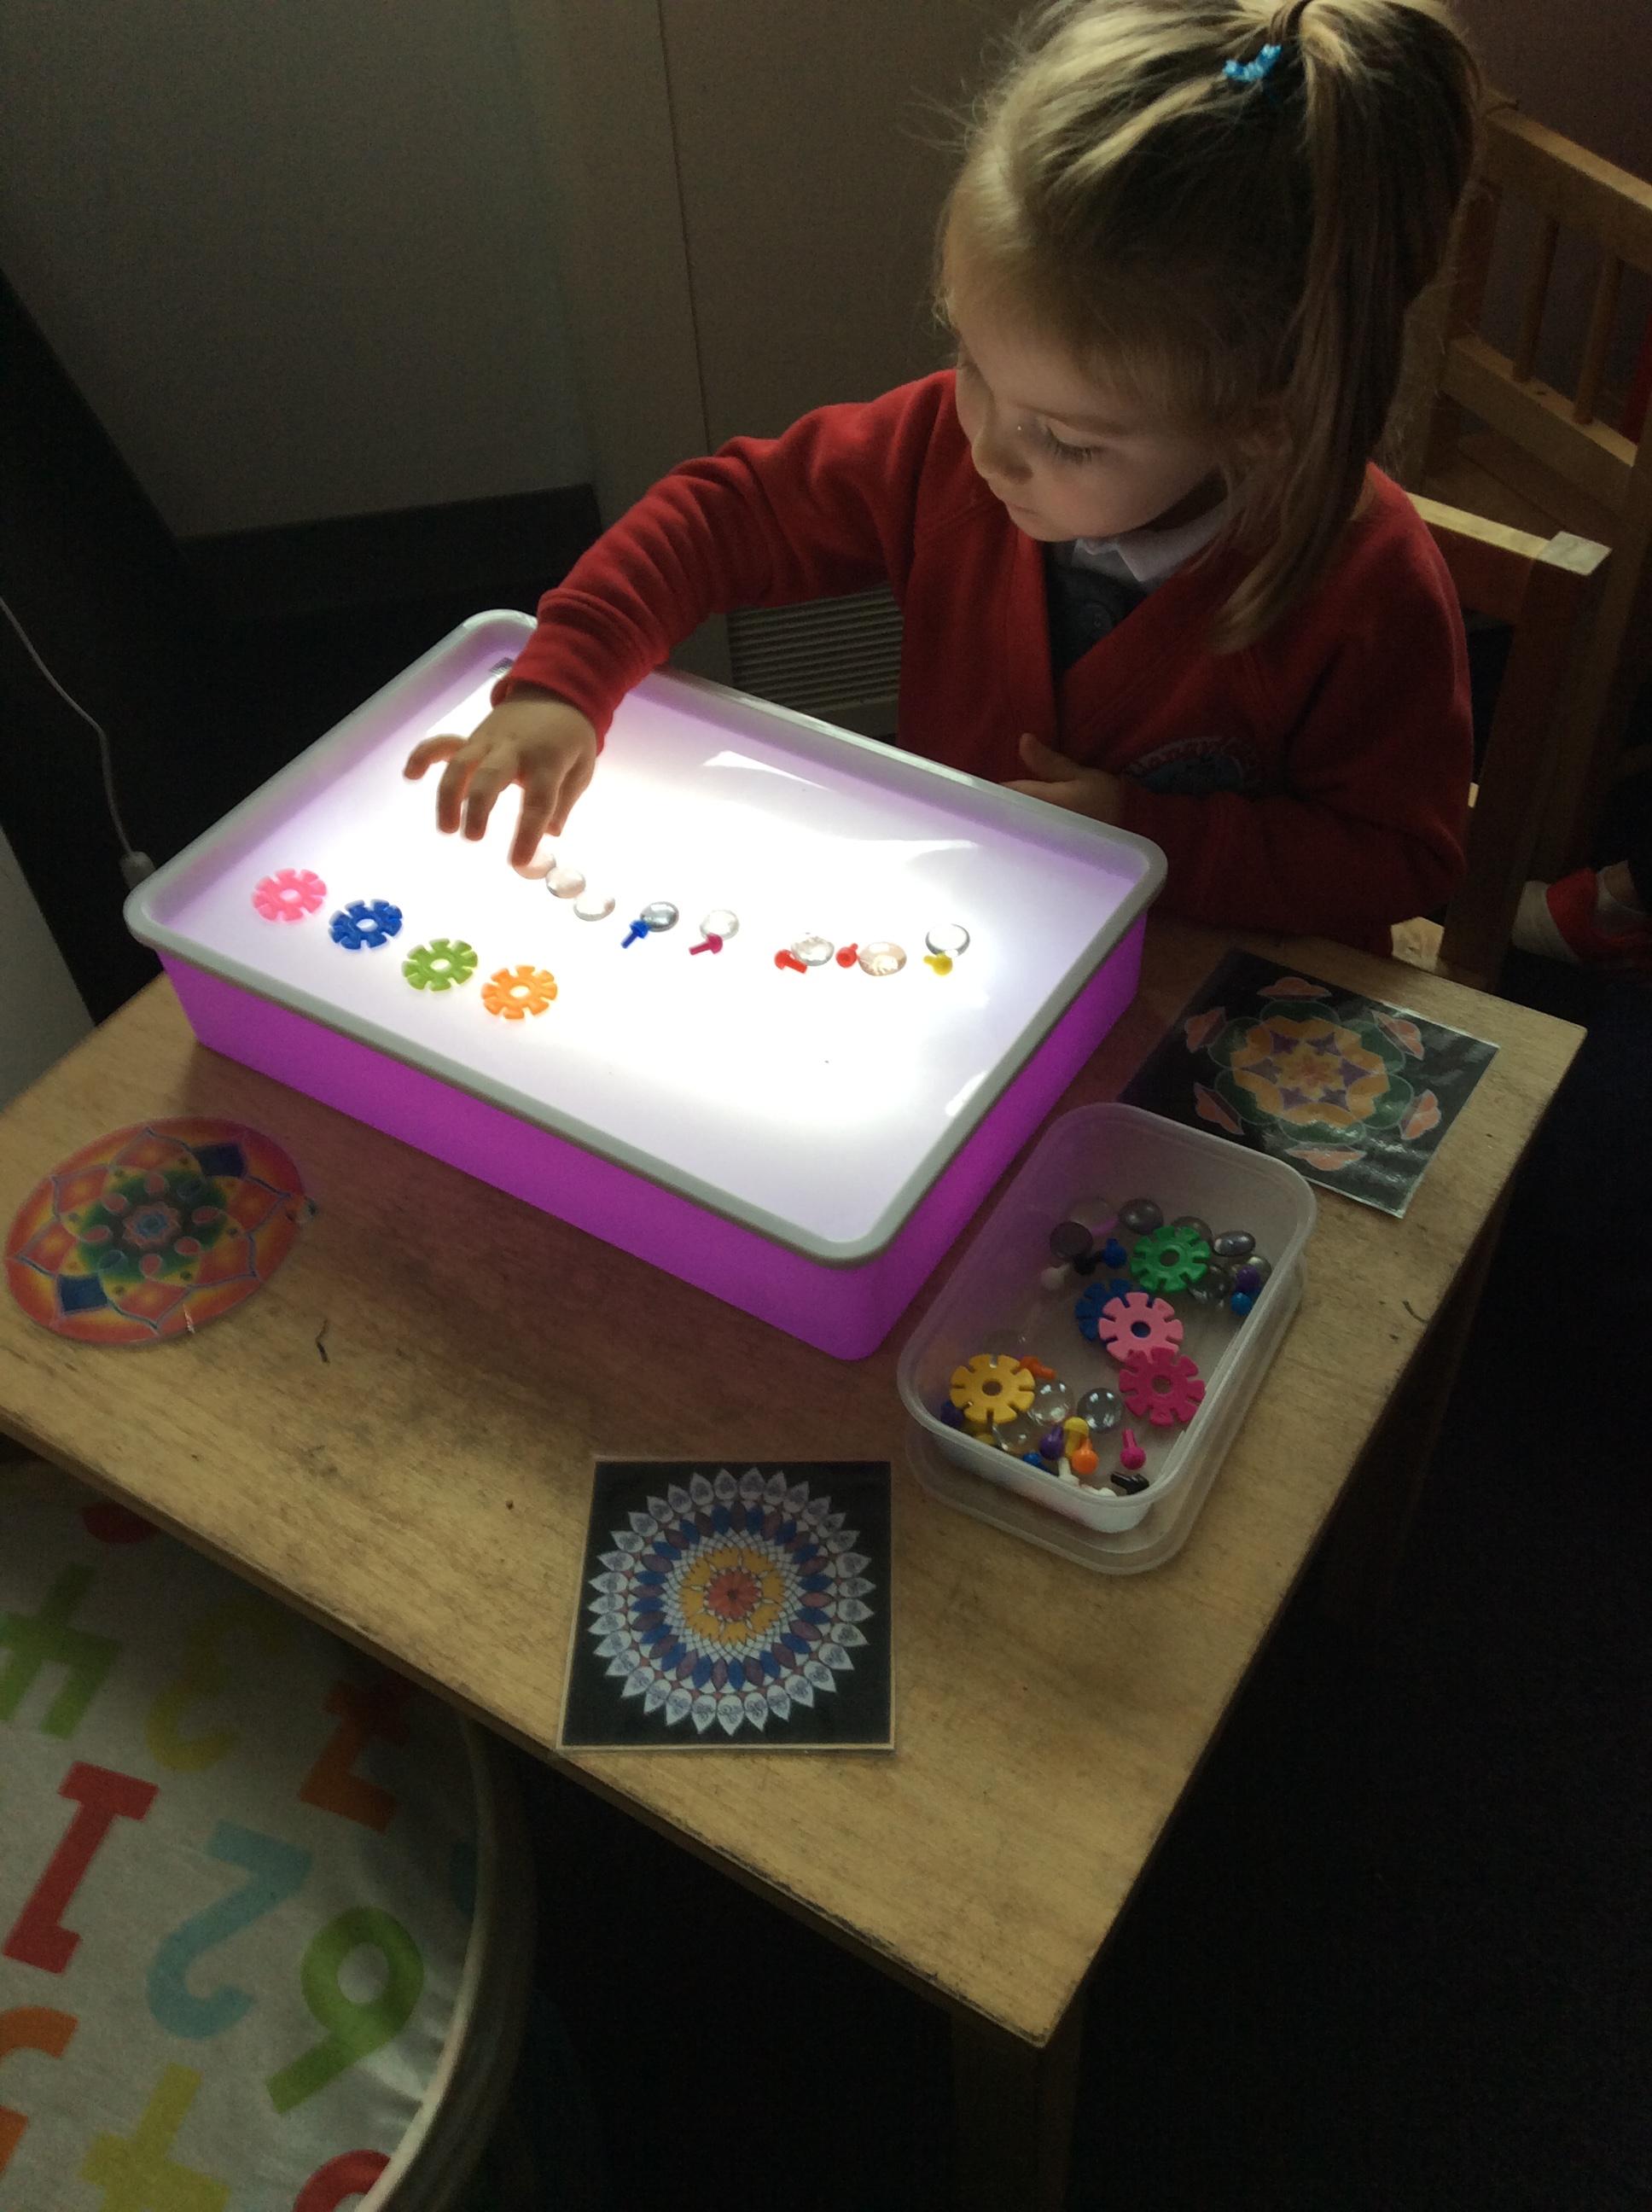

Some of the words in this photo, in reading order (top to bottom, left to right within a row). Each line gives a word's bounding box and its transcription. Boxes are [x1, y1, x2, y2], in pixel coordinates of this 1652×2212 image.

[148, 1599, 288, 1771] 3
[4, 1760, 159, 1974] 1
[147, 1820, 311, 2039] 2
